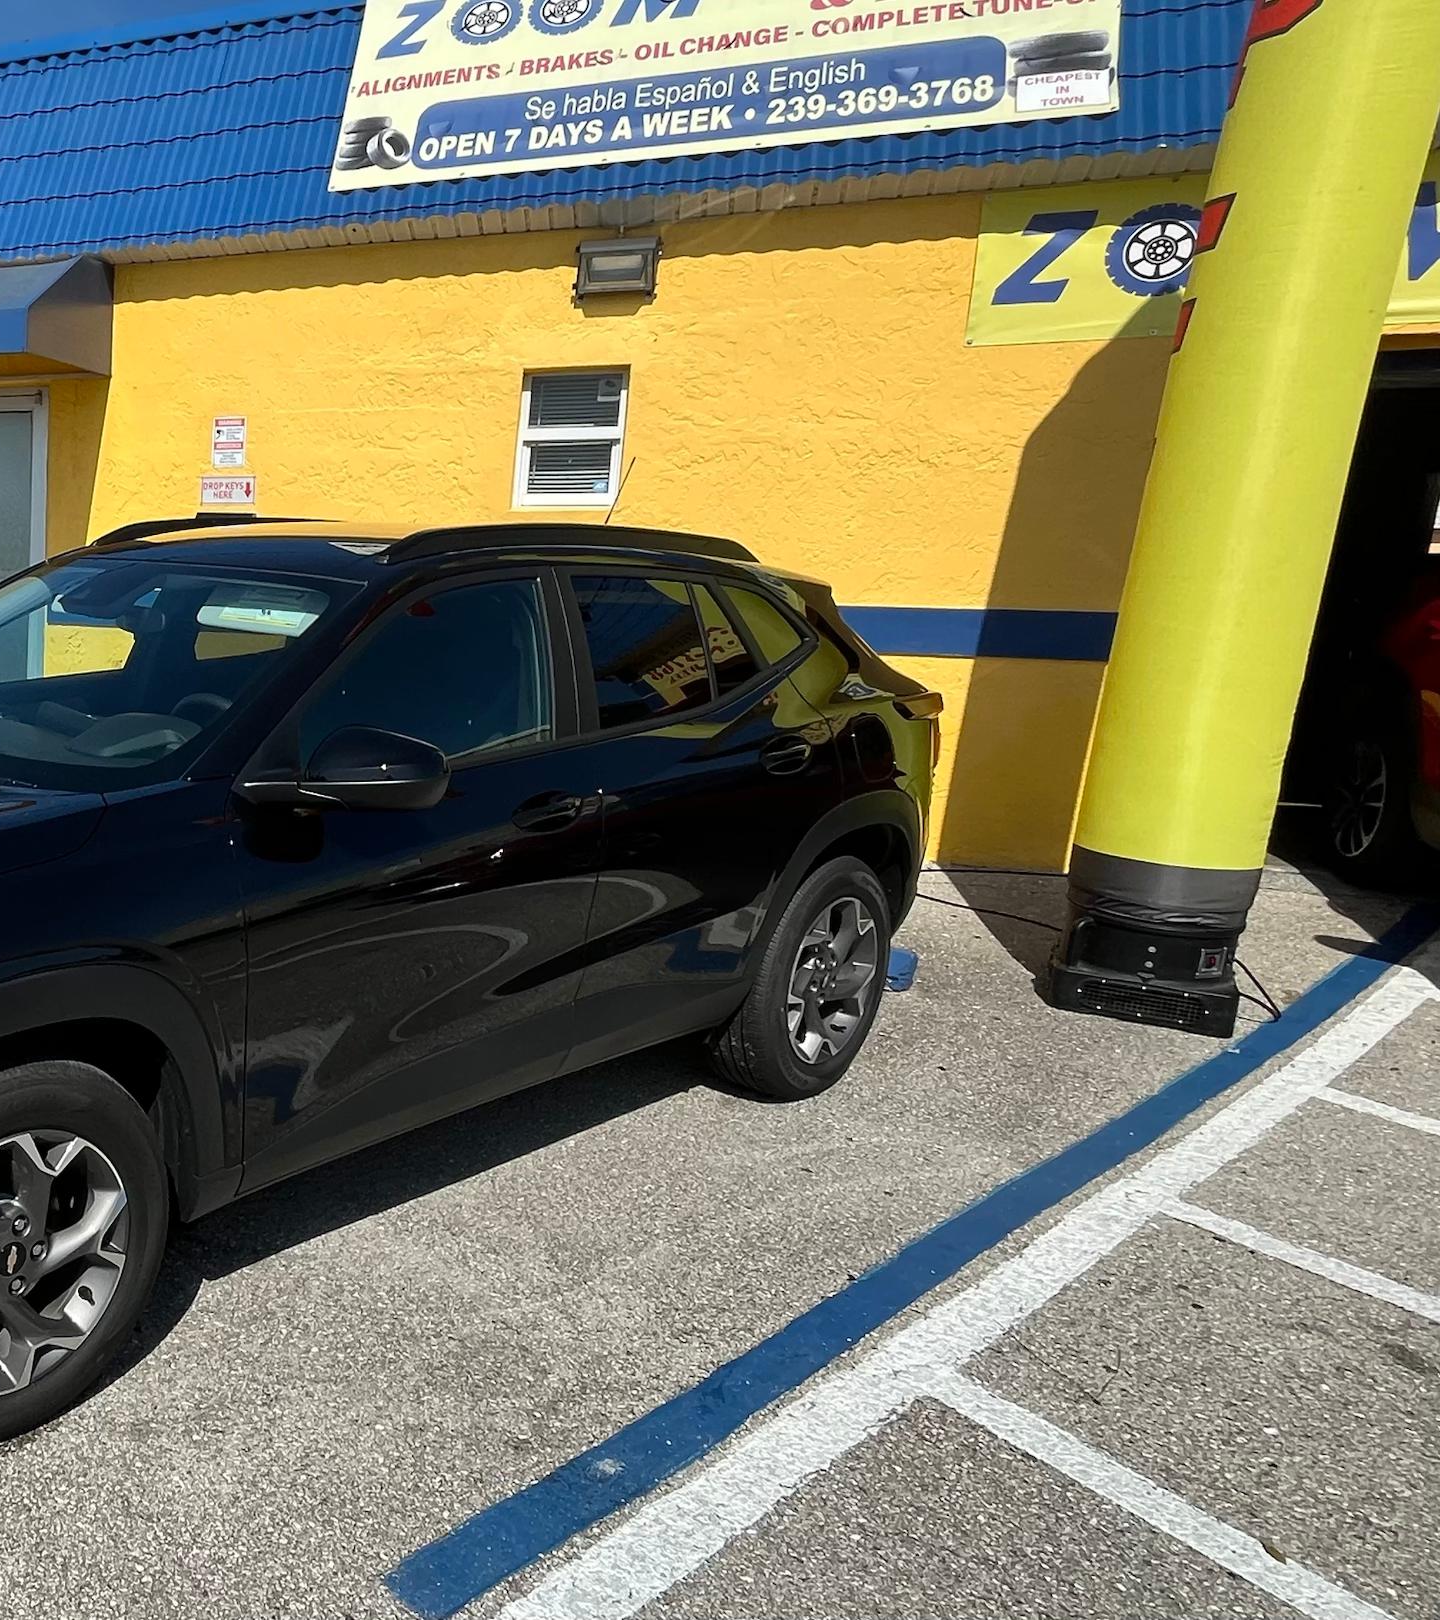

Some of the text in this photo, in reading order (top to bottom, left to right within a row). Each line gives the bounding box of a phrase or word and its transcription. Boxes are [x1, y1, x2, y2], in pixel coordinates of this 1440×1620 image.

[357, 63, 500, 97] ALIGNMENTS
[519, 49, 614, 76] BRAKES
[634, 42, 675, 61] OIL
[679, 25, 789, 53] CHANGE
[811, 3, 965, 38] COMPLETE
[972, 0, 1100, 17] TUNE-
[1024, 71, 1102, 87] CHEAPEST
[524, 58, 866, 121] Se habla Español & English
[1055, 85, 1071, 95] IN
[1040, 95, 1085, 107] TOWN
[418, 130, 497, 163] OPEN
[504, 127, 523, 154] 7
[527, 118, 604, 151] DAYS
[610, 115, 633, 142] A
[642, 104, 735, 139] WEEK
[765, 74, 995, 125] 239-369-3768
[203, 481, 244, 490] DROP KEYS
[213, 490, 233, 499] HERE
